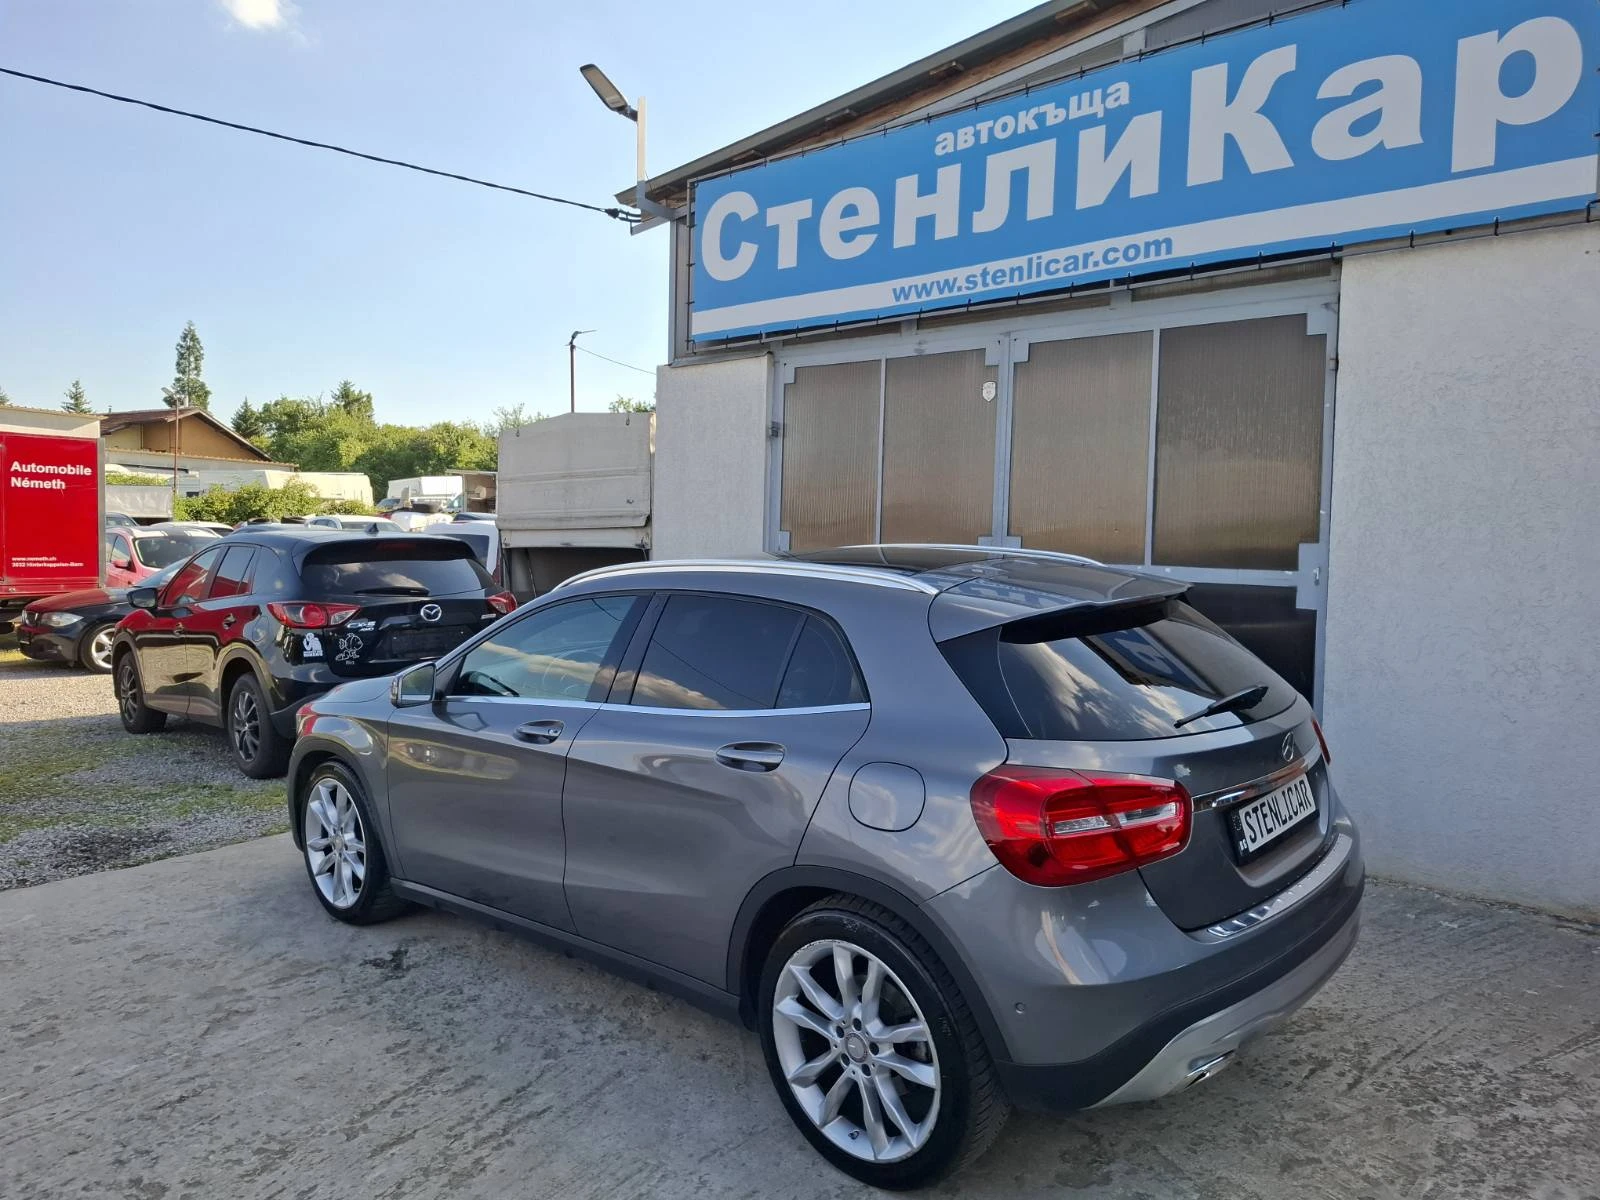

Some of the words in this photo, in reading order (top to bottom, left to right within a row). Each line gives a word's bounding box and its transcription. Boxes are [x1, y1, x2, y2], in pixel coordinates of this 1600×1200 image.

[701, 16, 1583, 282] СтенлиКар
[934, 81, 1130, 156] автокъща
[892, 236, 1173, 302] www.stenlicar.com
[10, 461, 92, 475] Automobile
[11, 477, 65, 489] Németh
[1244, 779, 1312, 844] STENLICAR
